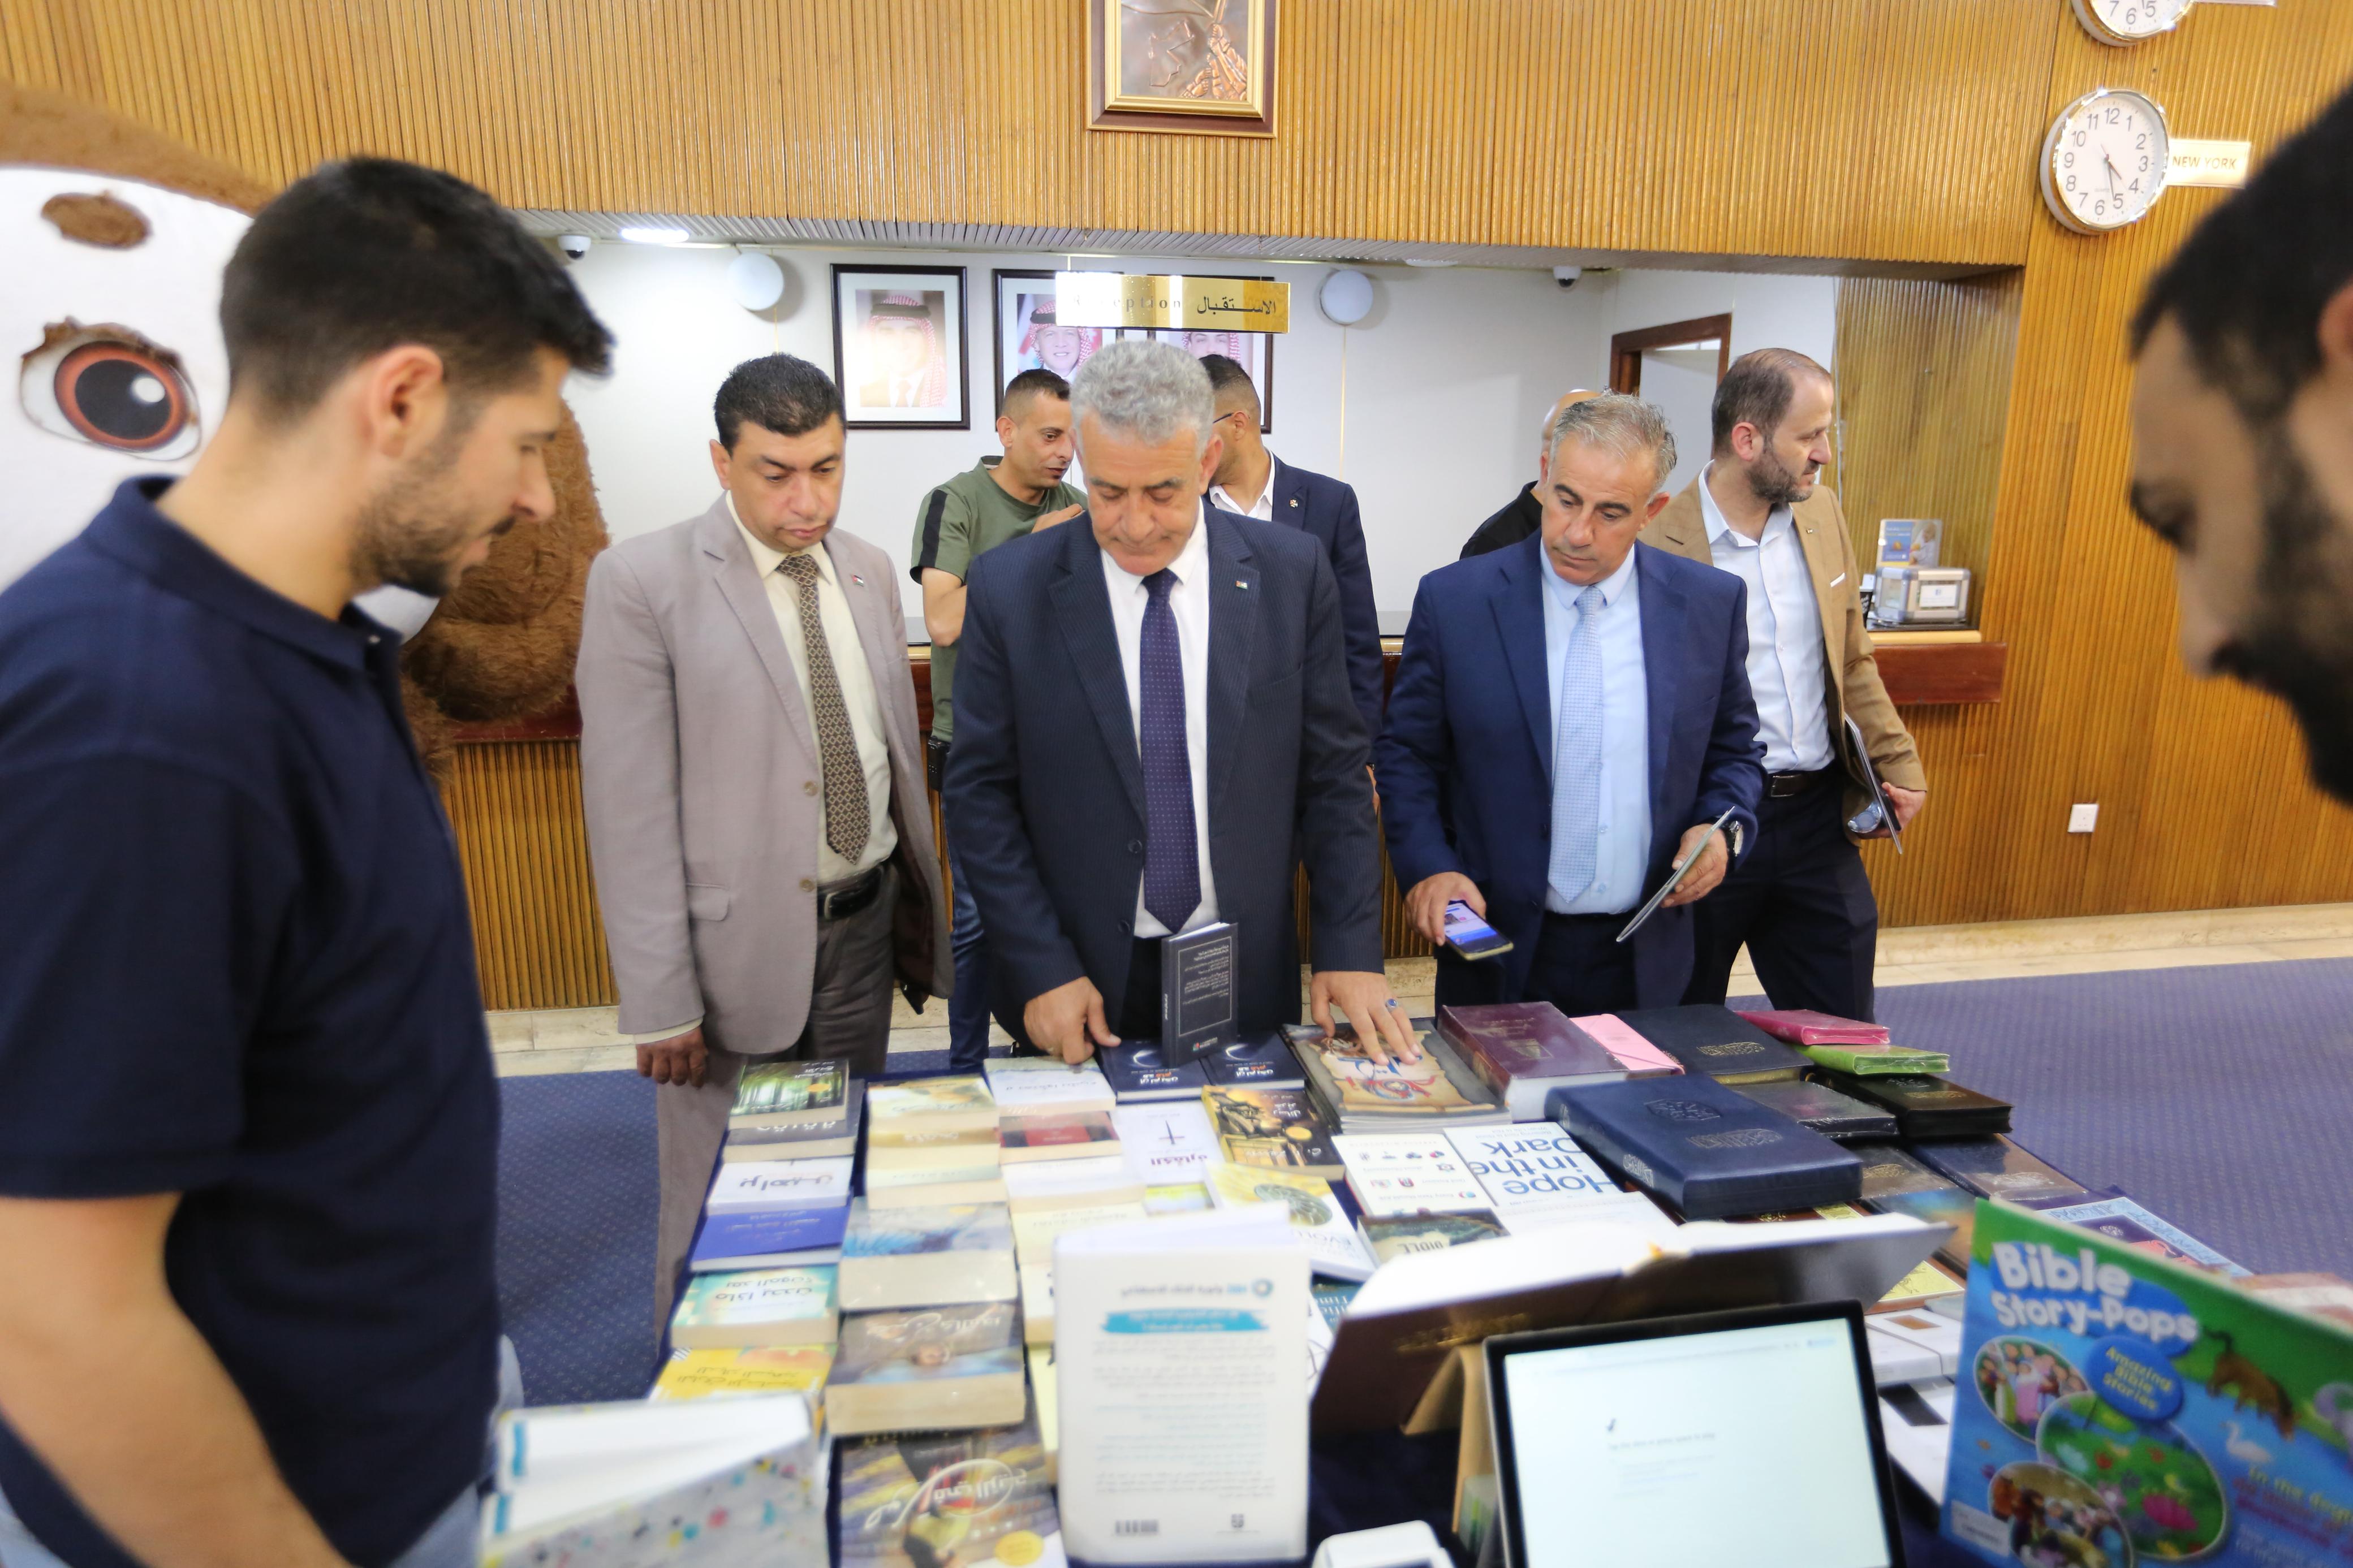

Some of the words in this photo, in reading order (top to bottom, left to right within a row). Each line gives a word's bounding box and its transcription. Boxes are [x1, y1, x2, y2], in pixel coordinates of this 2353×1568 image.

[2126, 8, 2137, 24] 6
[2145, 2, 2156, 18] 5
[2087, 114, 2099, 130] 11
[2104, 107, 2120, 124] 12
[2126, 115, 2132, 132] 1
[2071, 130, 2086, 147] 10
[2135, 133, 2146, 150] 2
[2063, 152, 2075, 169] 9
[2138, 155, 2148, 172] 3
[2173, 156, 2200, 168] NEW
[2203, 157, 2236, 170] YORK
[2066, 175, 2076, 192] 8
[2128, 178, 2139, 194] 4
[2079, 192, 2088, 208] 7
[2095, 199, 2105, 215] 6
[2113, 193, 2123, 209] 5
[1196, 296, 1277, 315] الاستقبال
[1480, 1137, 1584, 1158] Dark
[1468, 1159, 1536, 1177] the
[1536, 1155, 1583, 1173] in
[739, 1174, 833, 1191] براهين
[1502, 1173, 1613, 1195] Hope
[1992, 1241, 2133, 1297] Bible
[1991, 1291, 2199, 1344] Story-Pops
[2105, 1346, 2172, 1392] Amazing
[2115, 1365, 2153, 1394] Bible
